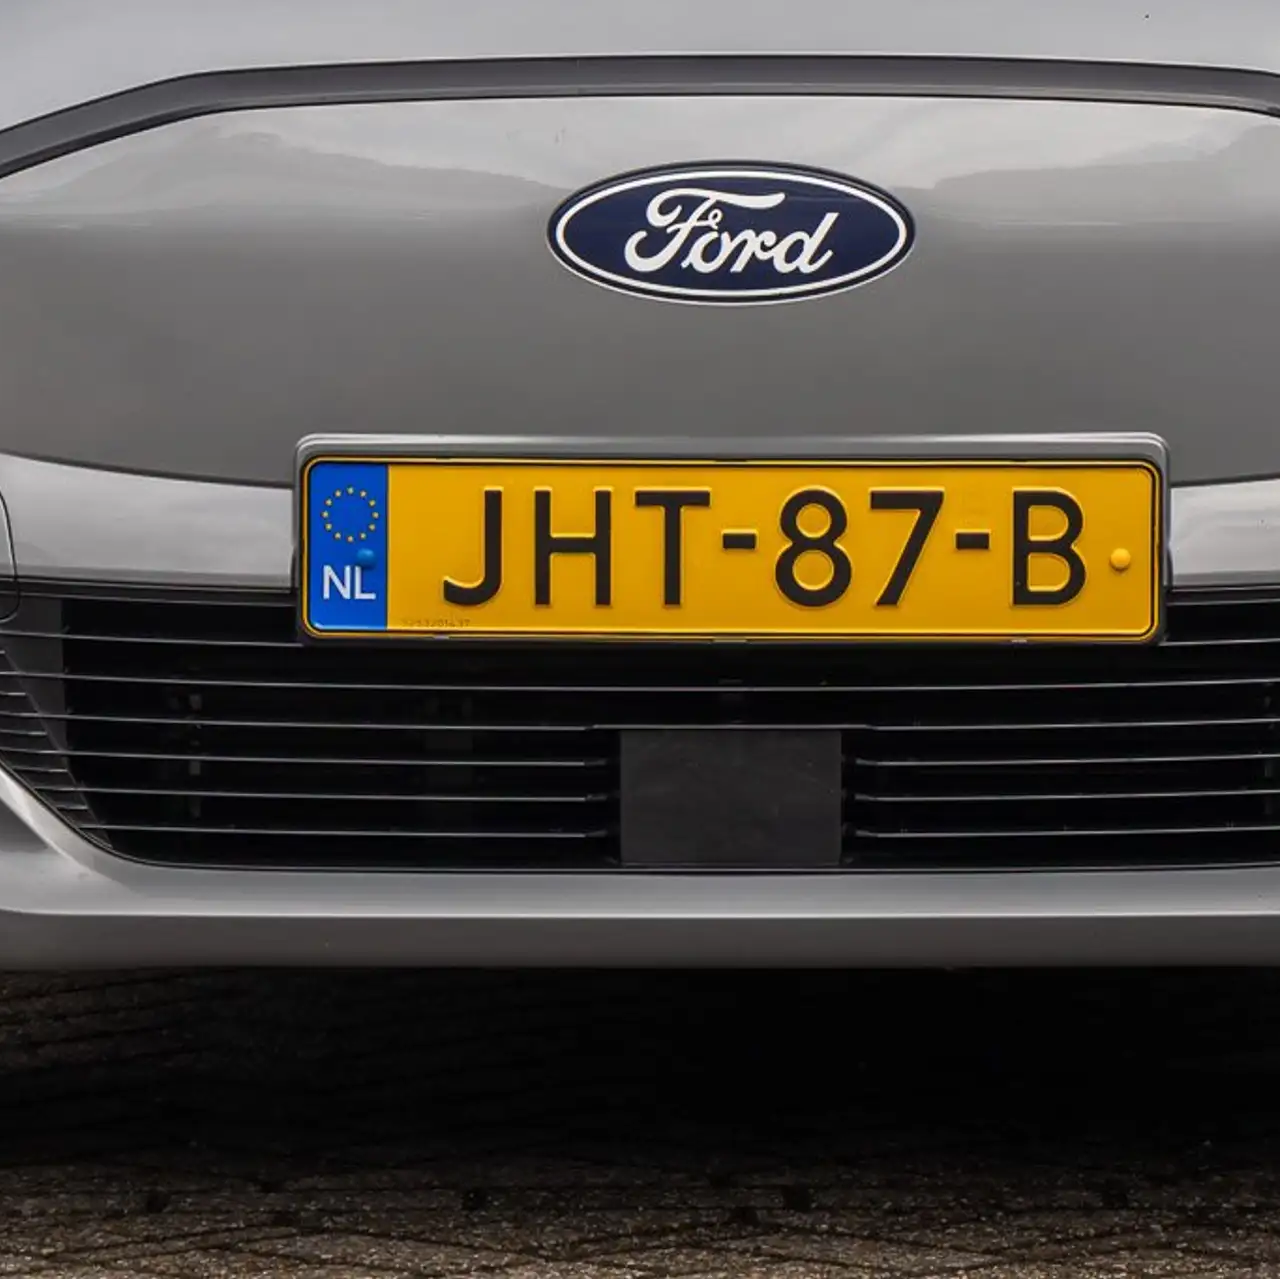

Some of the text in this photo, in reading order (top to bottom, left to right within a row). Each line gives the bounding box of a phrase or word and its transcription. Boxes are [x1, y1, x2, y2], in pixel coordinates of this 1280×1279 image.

[624, 187, 840, 274] Ford
[321, 565, 377, 601] NL
[442, 488, 1088, 609] JHT-87-B
